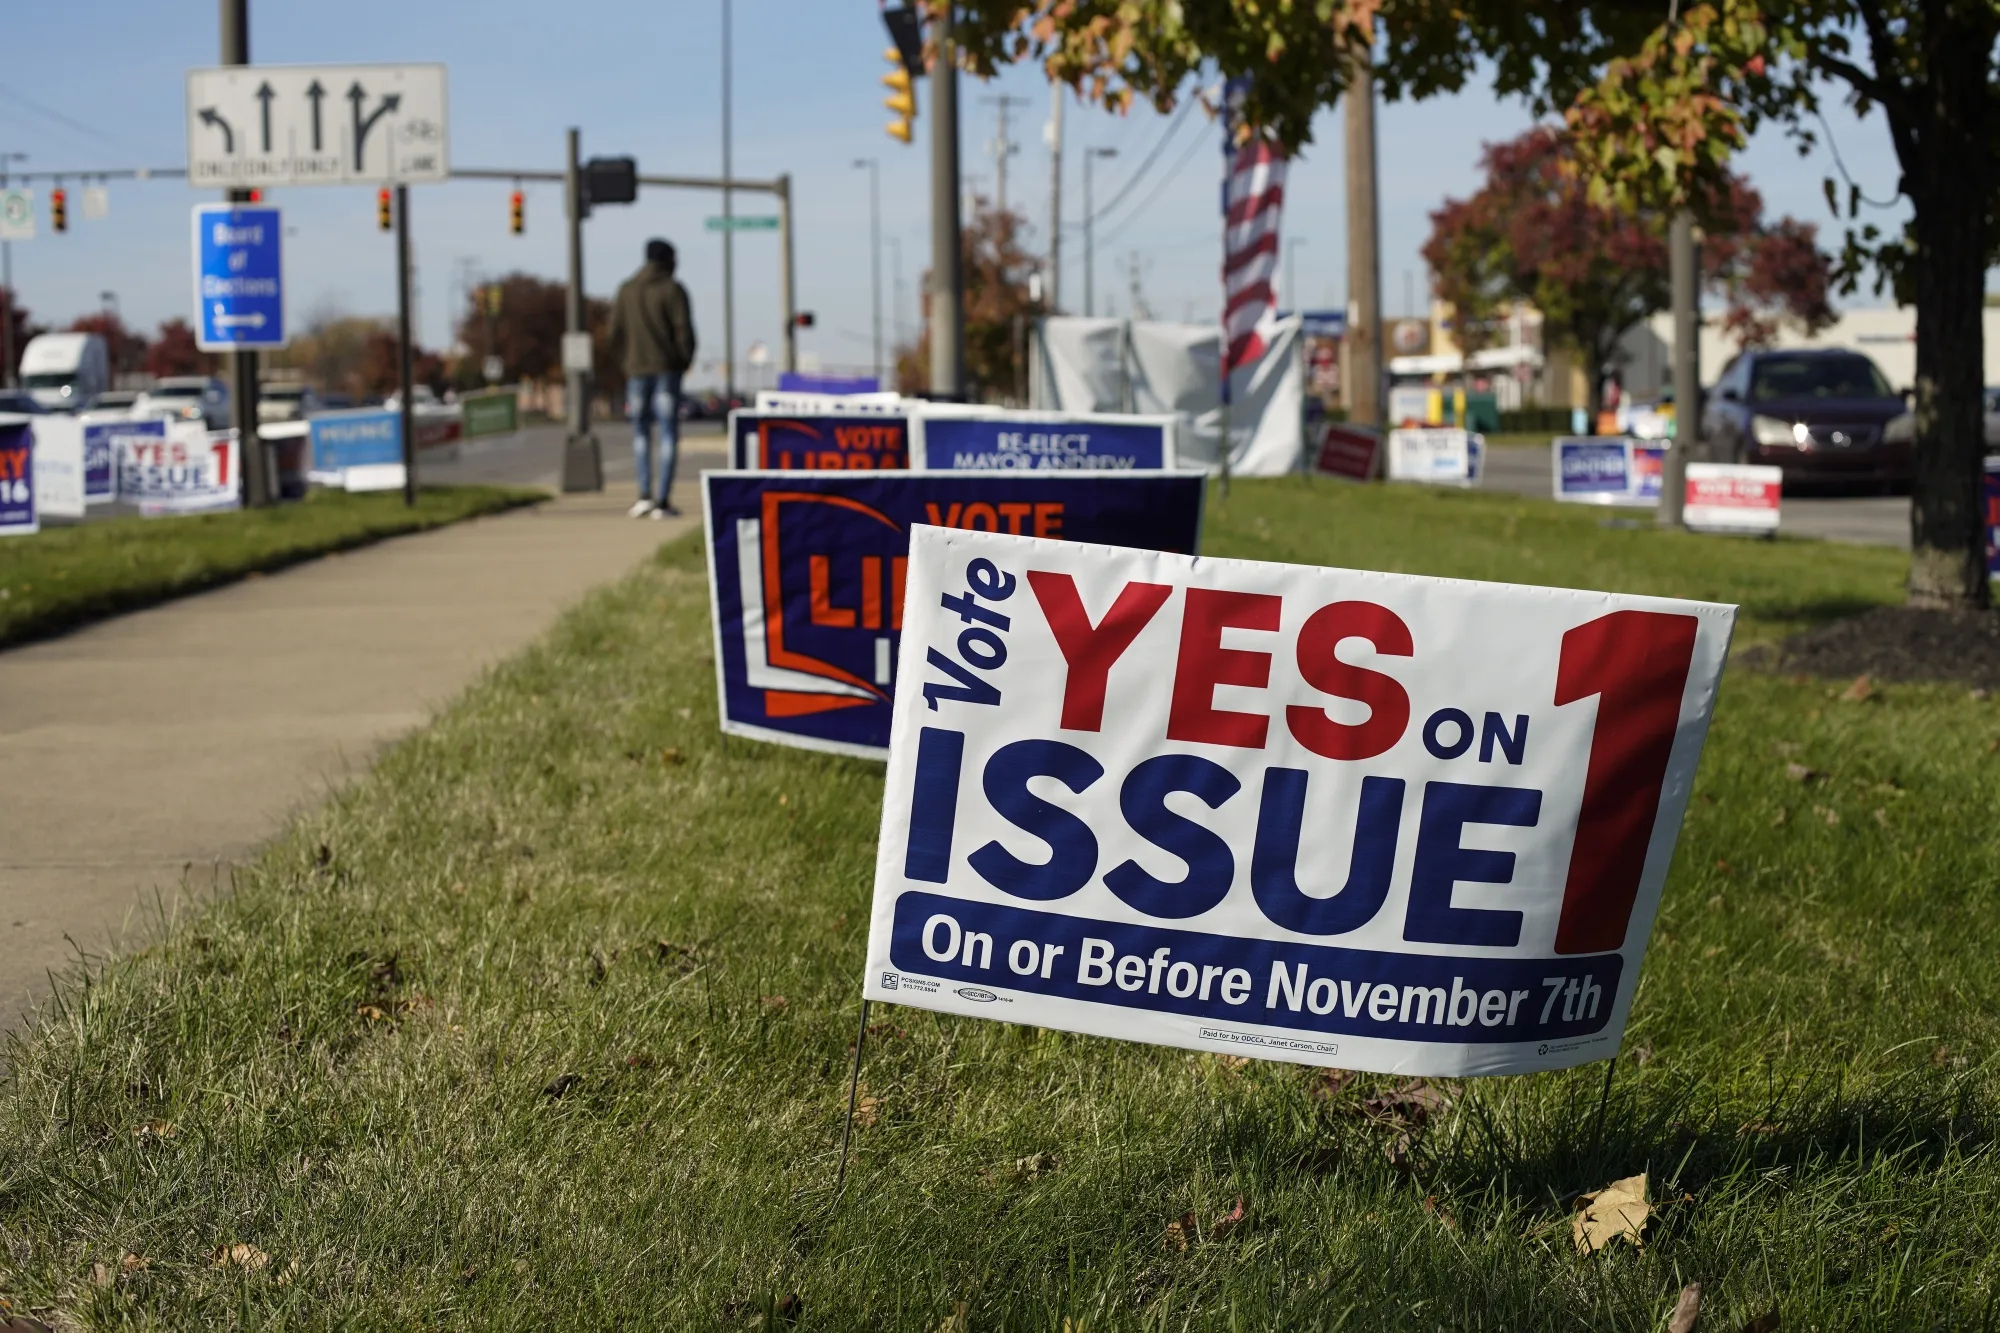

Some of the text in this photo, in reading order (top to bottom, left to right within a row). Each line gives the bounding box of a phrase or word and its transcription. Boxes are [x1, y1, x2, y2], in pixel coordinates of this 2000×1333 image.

[212, 222, 264, 246] Board
[228, 249, 248, 272] of
[202, 274, 278, 298] Elections
[834, 425, 901, 449] VOTE
[997, 432, 1090, 455] RE-ELECT
[132, 441, 187, 465] YES
[953, 452, 1136, 470] MAYOR ANDREW
[117, 464, 210, 490] ISSUE
[210, 441, 228, 487] 1
[0, 479, 29, 504] 16
[925, 502, 1064, 540] VOTE
[924, 557, 1016, 711] Vote
[1026, 571, 1529, 765] YES ON
[905, 610, 1697, 955] ISSUE 1
[922, 914, 1602, 1027] On or Before November 7th
[1203, 1030, 1217, 1038] Paid
[1219, 1031, 1229, 1039] for
[1231, 1033, 1239, 1041] by
[1268, 1038, 1288, 1047] Janet
[1289, 1041, 1314, 1050] Carson,
[1316, 1044, 1335, 1053] Chair
